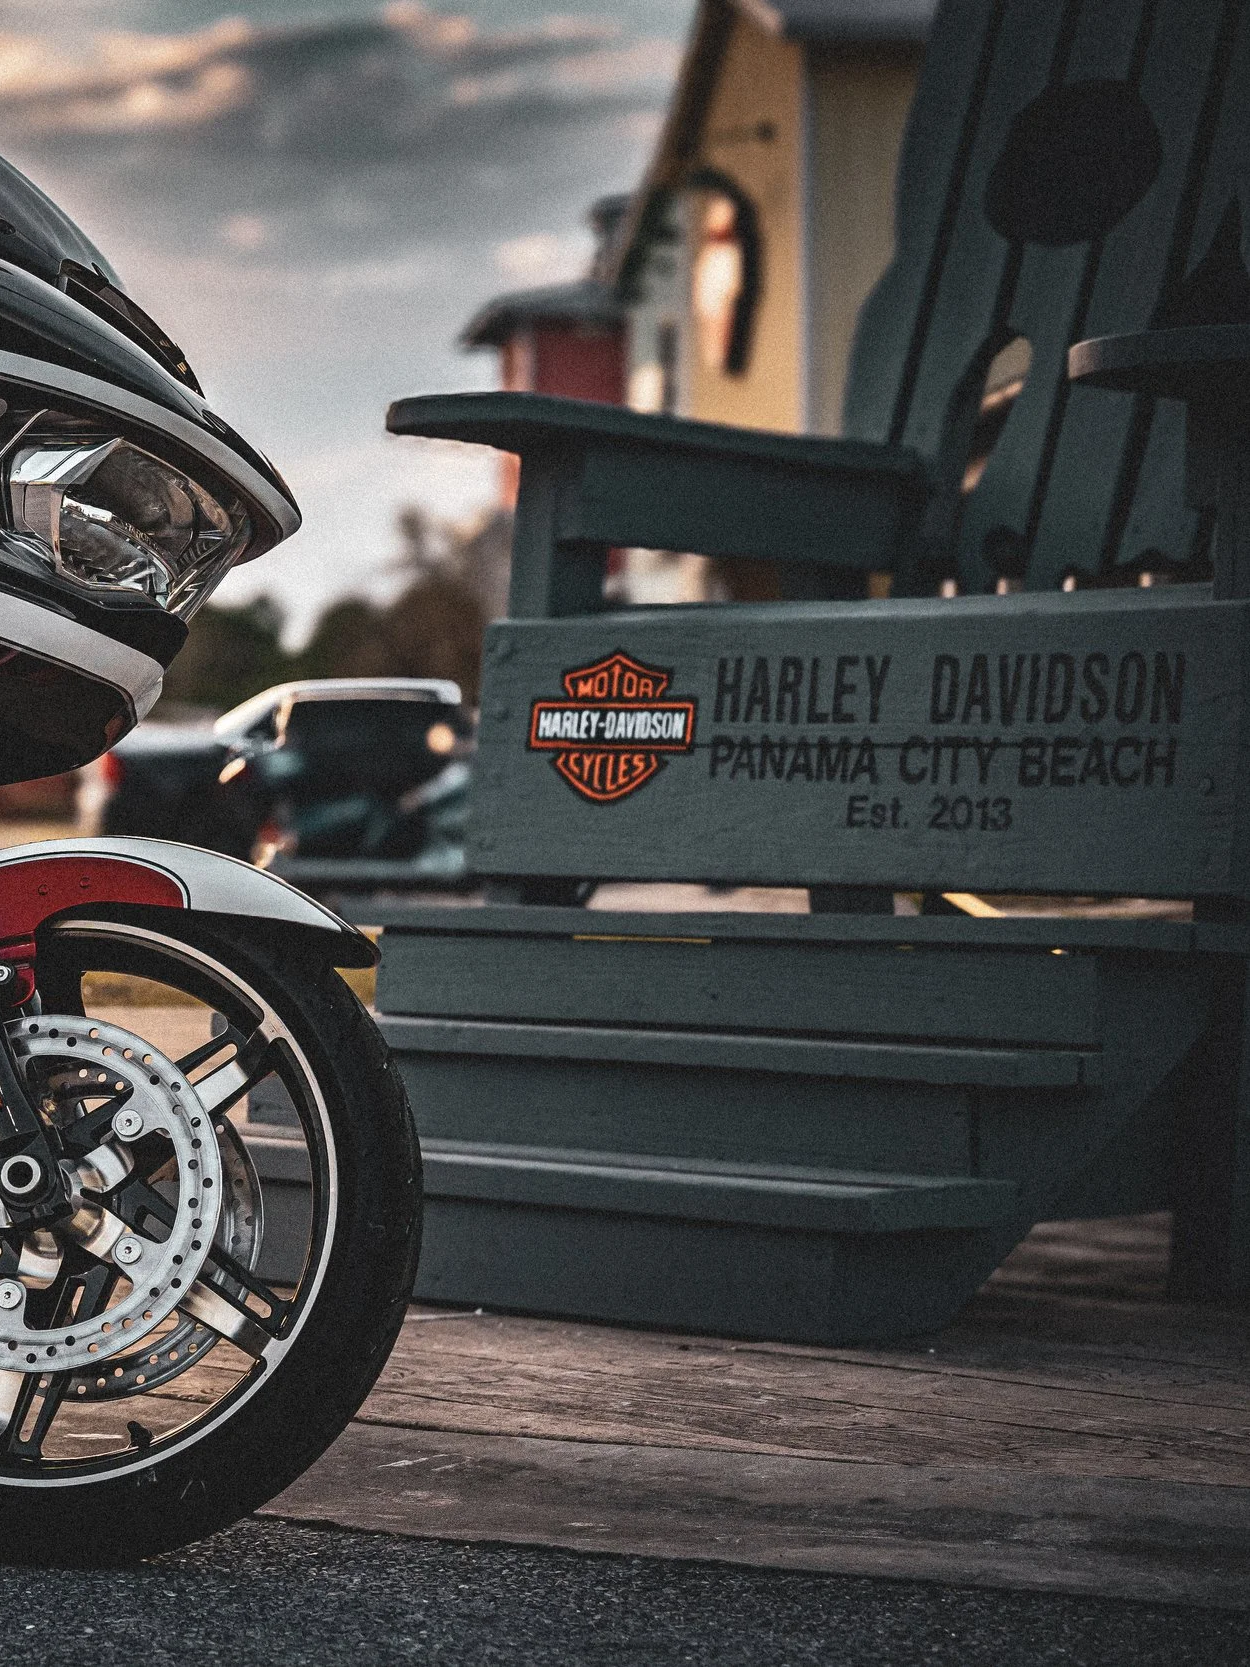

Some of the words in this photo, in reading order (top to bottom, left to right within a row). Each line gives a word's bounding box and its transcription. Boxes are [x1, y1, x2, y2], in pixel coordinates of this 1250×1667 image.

[577, 664, 653, 698] MOTOR
[713, 655, 892, 724] HARLEY
[929, 652, 1186, 726] DAVIDSON
[538, 711, 686, 739] HARLEY-DAVIDSON
[568, 753, 645, 791] CYCLES
[709, 735, 879, 784] PANAMA
[900, 735, 1000, 785] CITY
[1017, 736, 1178, 787] BEACH
[846, 795, 908, 829] Est.
[928, 795, 1013, 831] 2013
